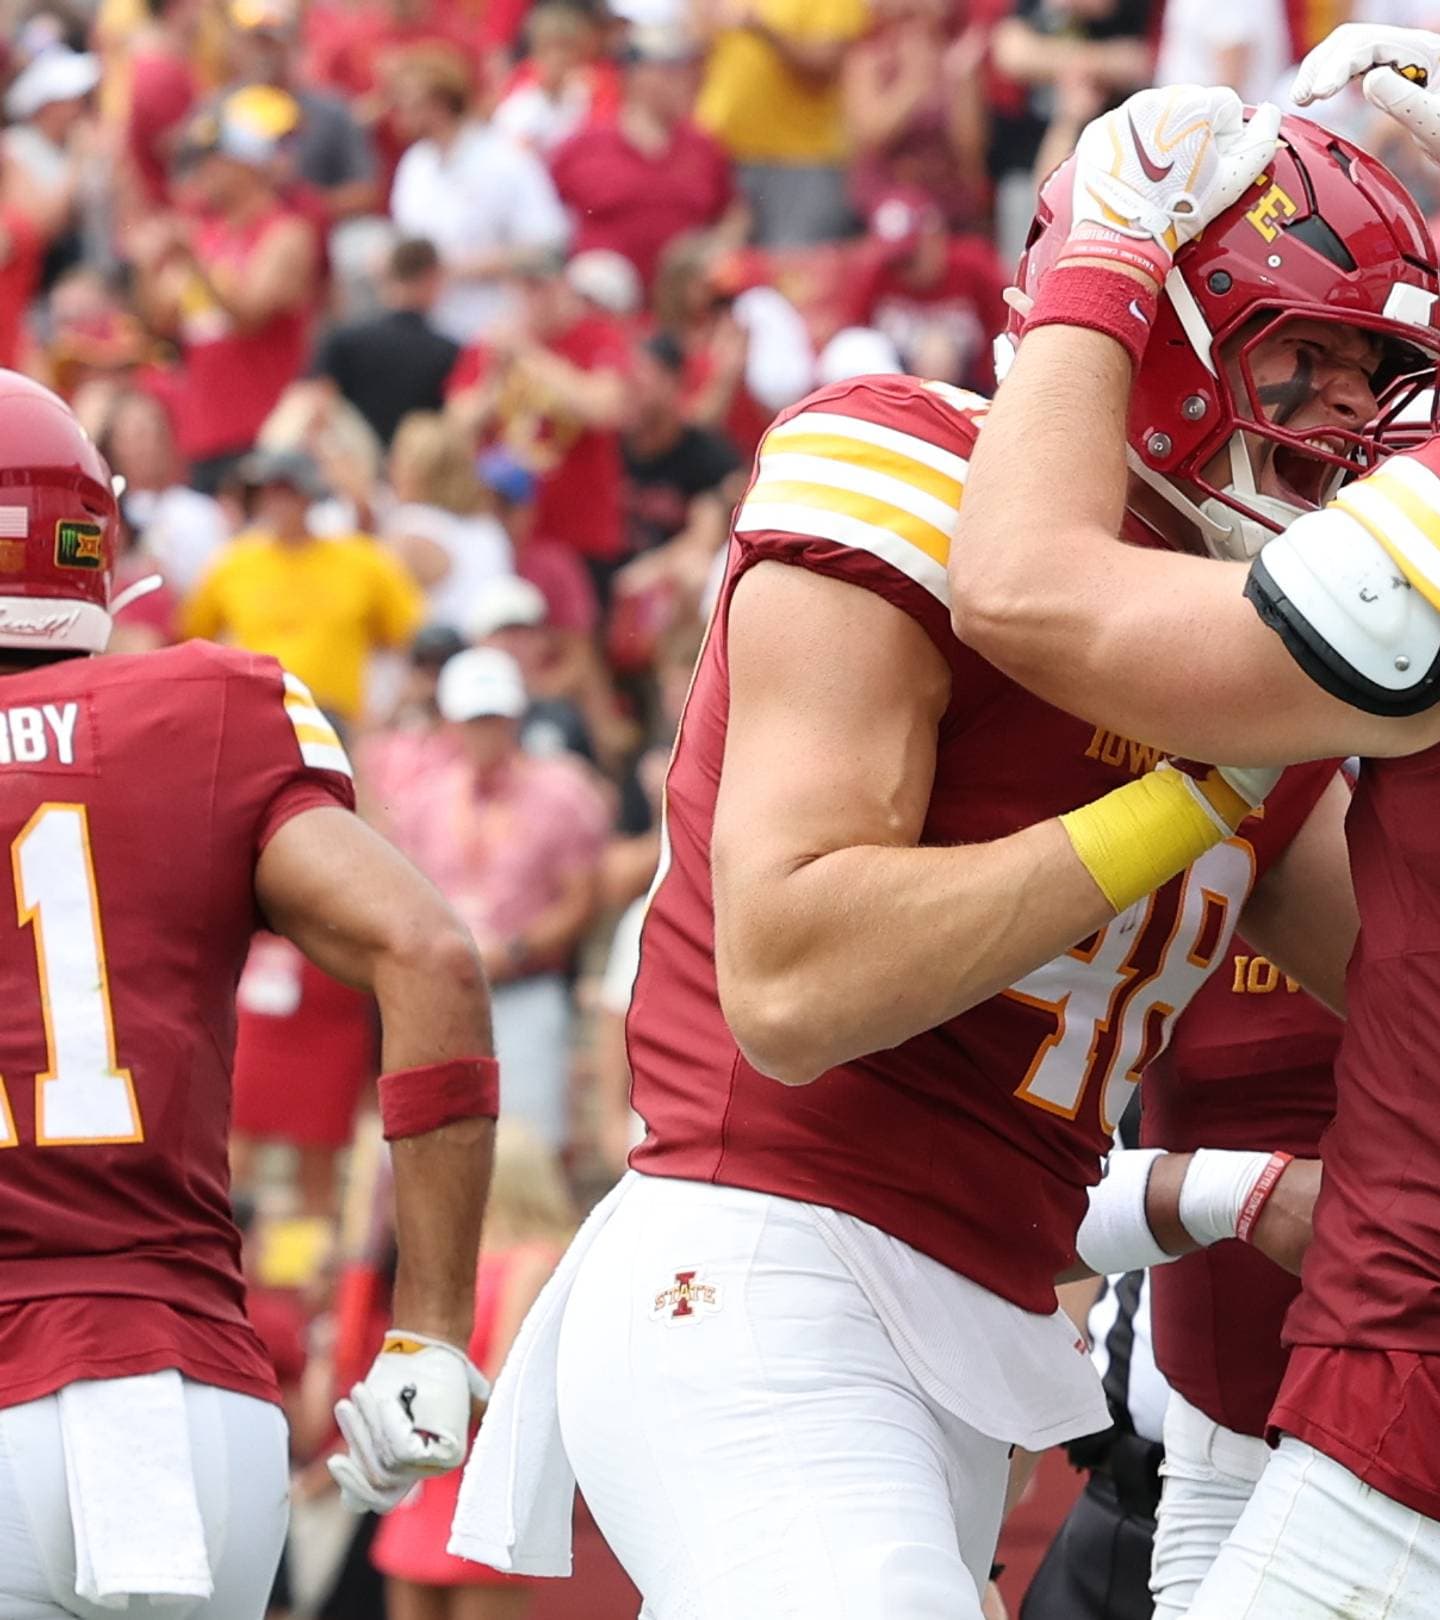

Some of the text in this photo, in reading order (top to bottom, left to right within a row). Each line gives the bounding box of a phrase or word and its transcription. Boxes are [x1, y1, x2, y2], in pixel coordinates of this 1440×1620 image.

[0, 702, 78, 765] BY
[1084, 727, 1164, 775] IOW
[0, 801, 145, 1146] 1
[654, 1284, 716, 1313] STATE
